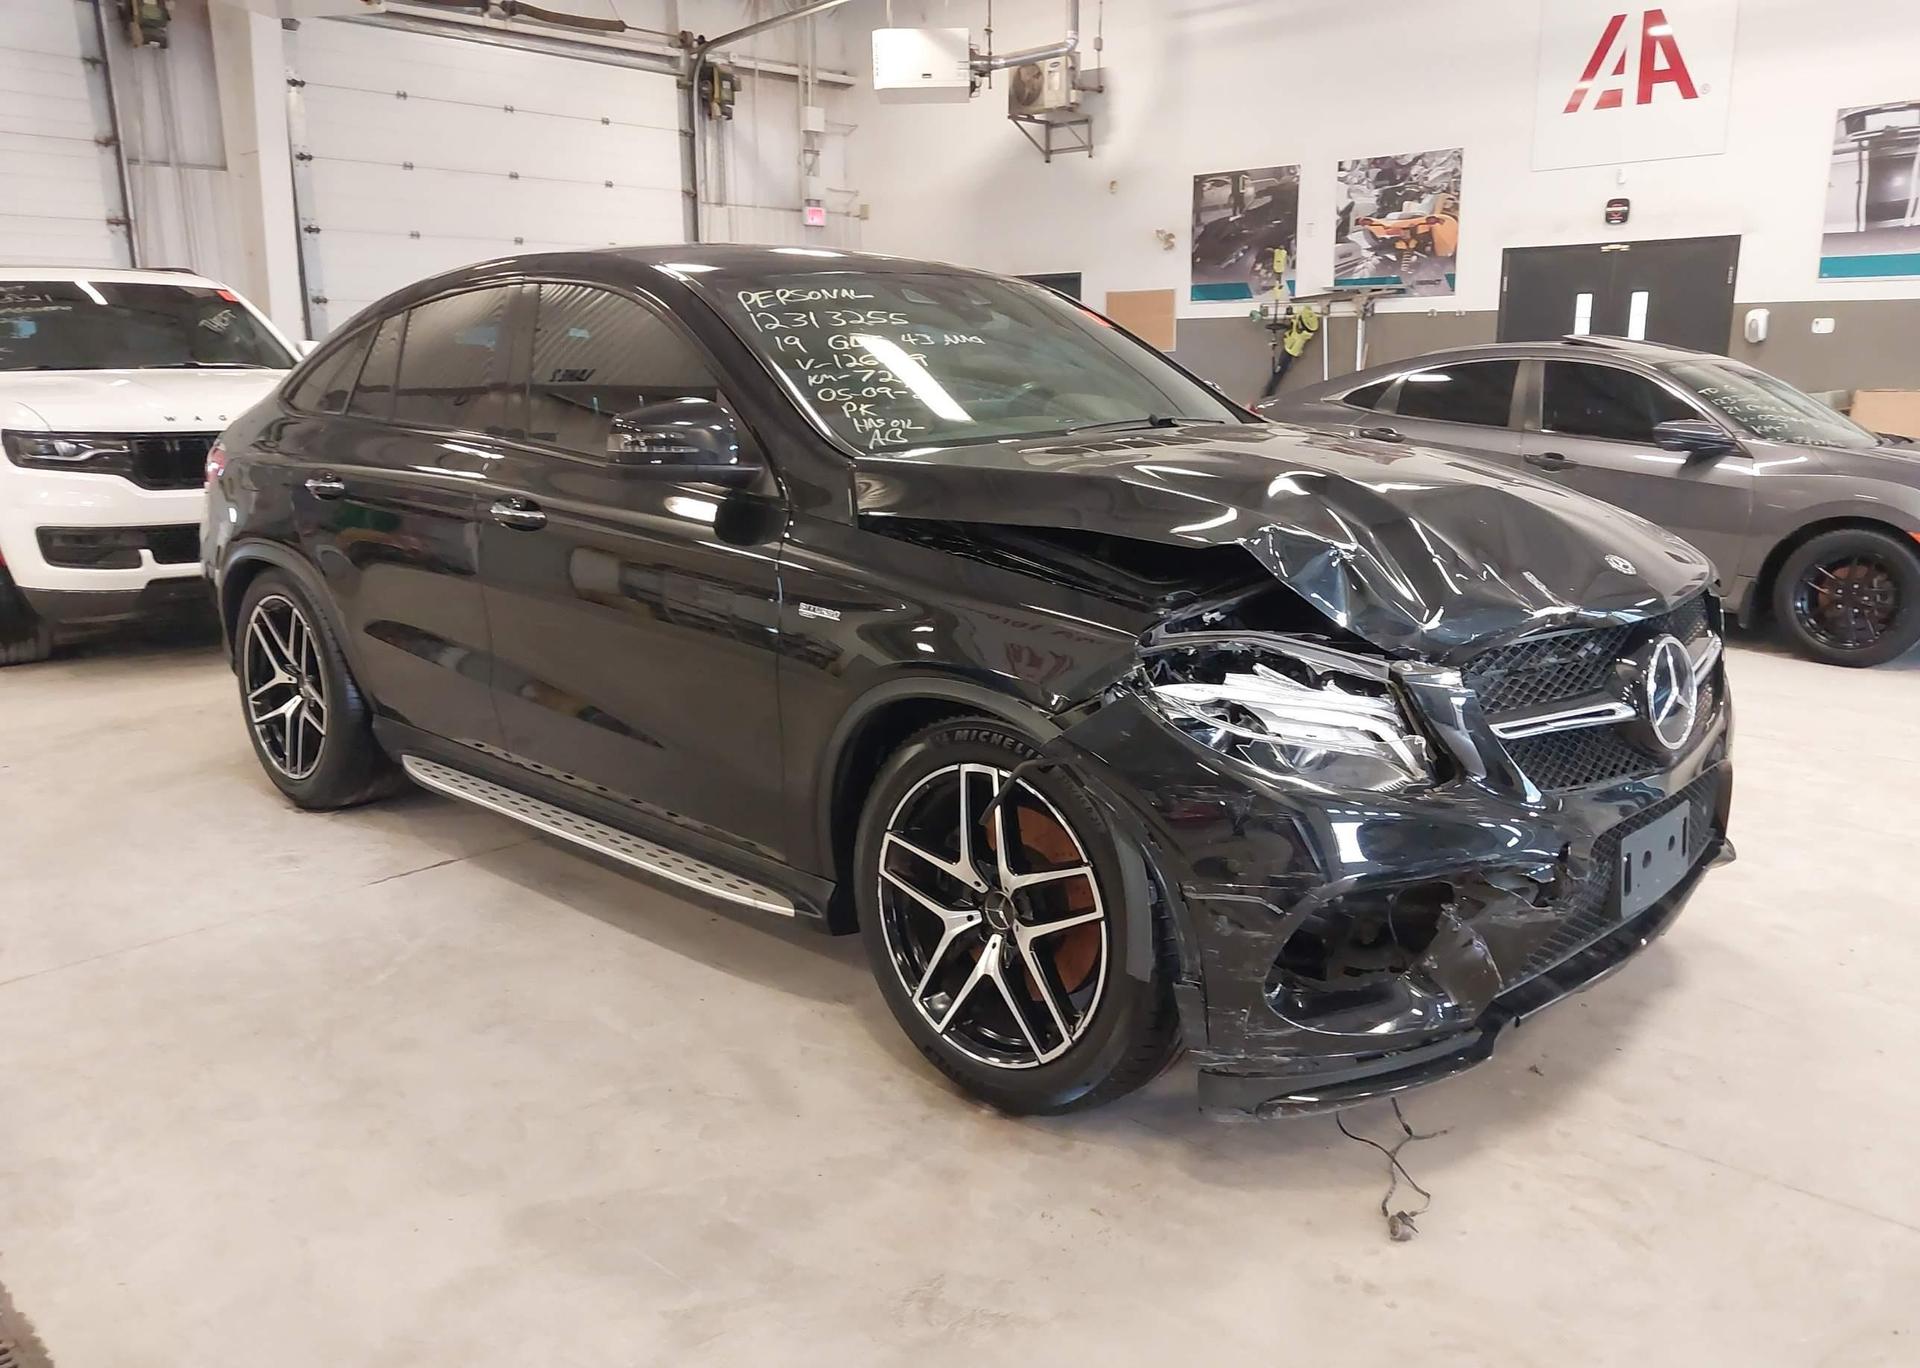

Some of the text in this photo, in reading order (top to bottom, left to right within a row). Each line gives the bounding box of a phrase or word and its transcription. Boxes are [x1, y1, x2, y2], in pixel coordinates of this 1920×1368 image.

[738, 288, 875, 311] PERSONAL
[775, 336, 808, 353] 19
[841, 401, 878, 418] PK
